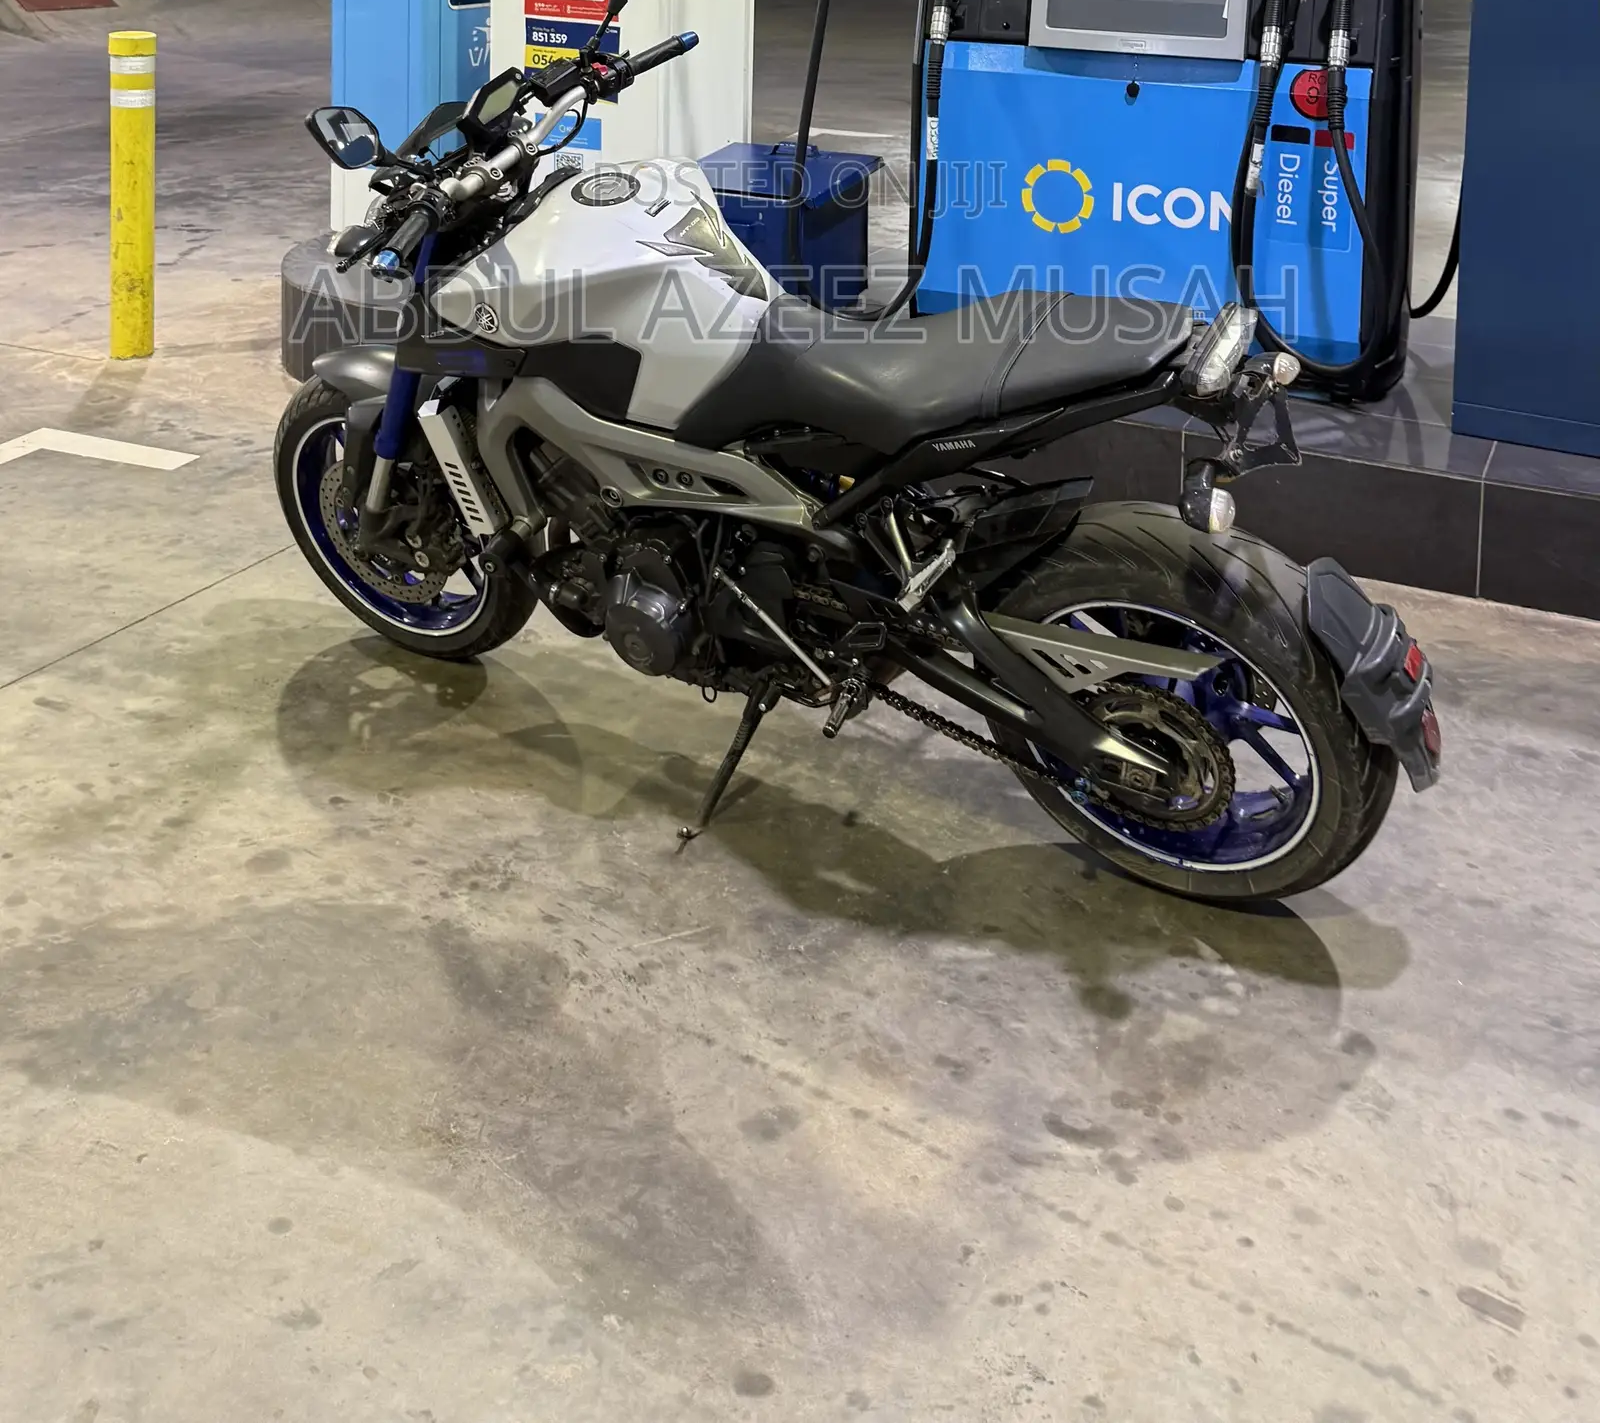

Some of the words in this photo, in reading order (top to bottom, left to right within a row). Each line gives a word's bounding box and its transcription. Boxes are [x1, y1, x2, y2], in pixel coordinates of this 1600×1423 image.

[549, 32, 568, 44] 359
[1276, 153, 1300, 226] Diesel
[1317, 160, 1339, 233] Super
[931, 439, 977, 452] YAMAHA
